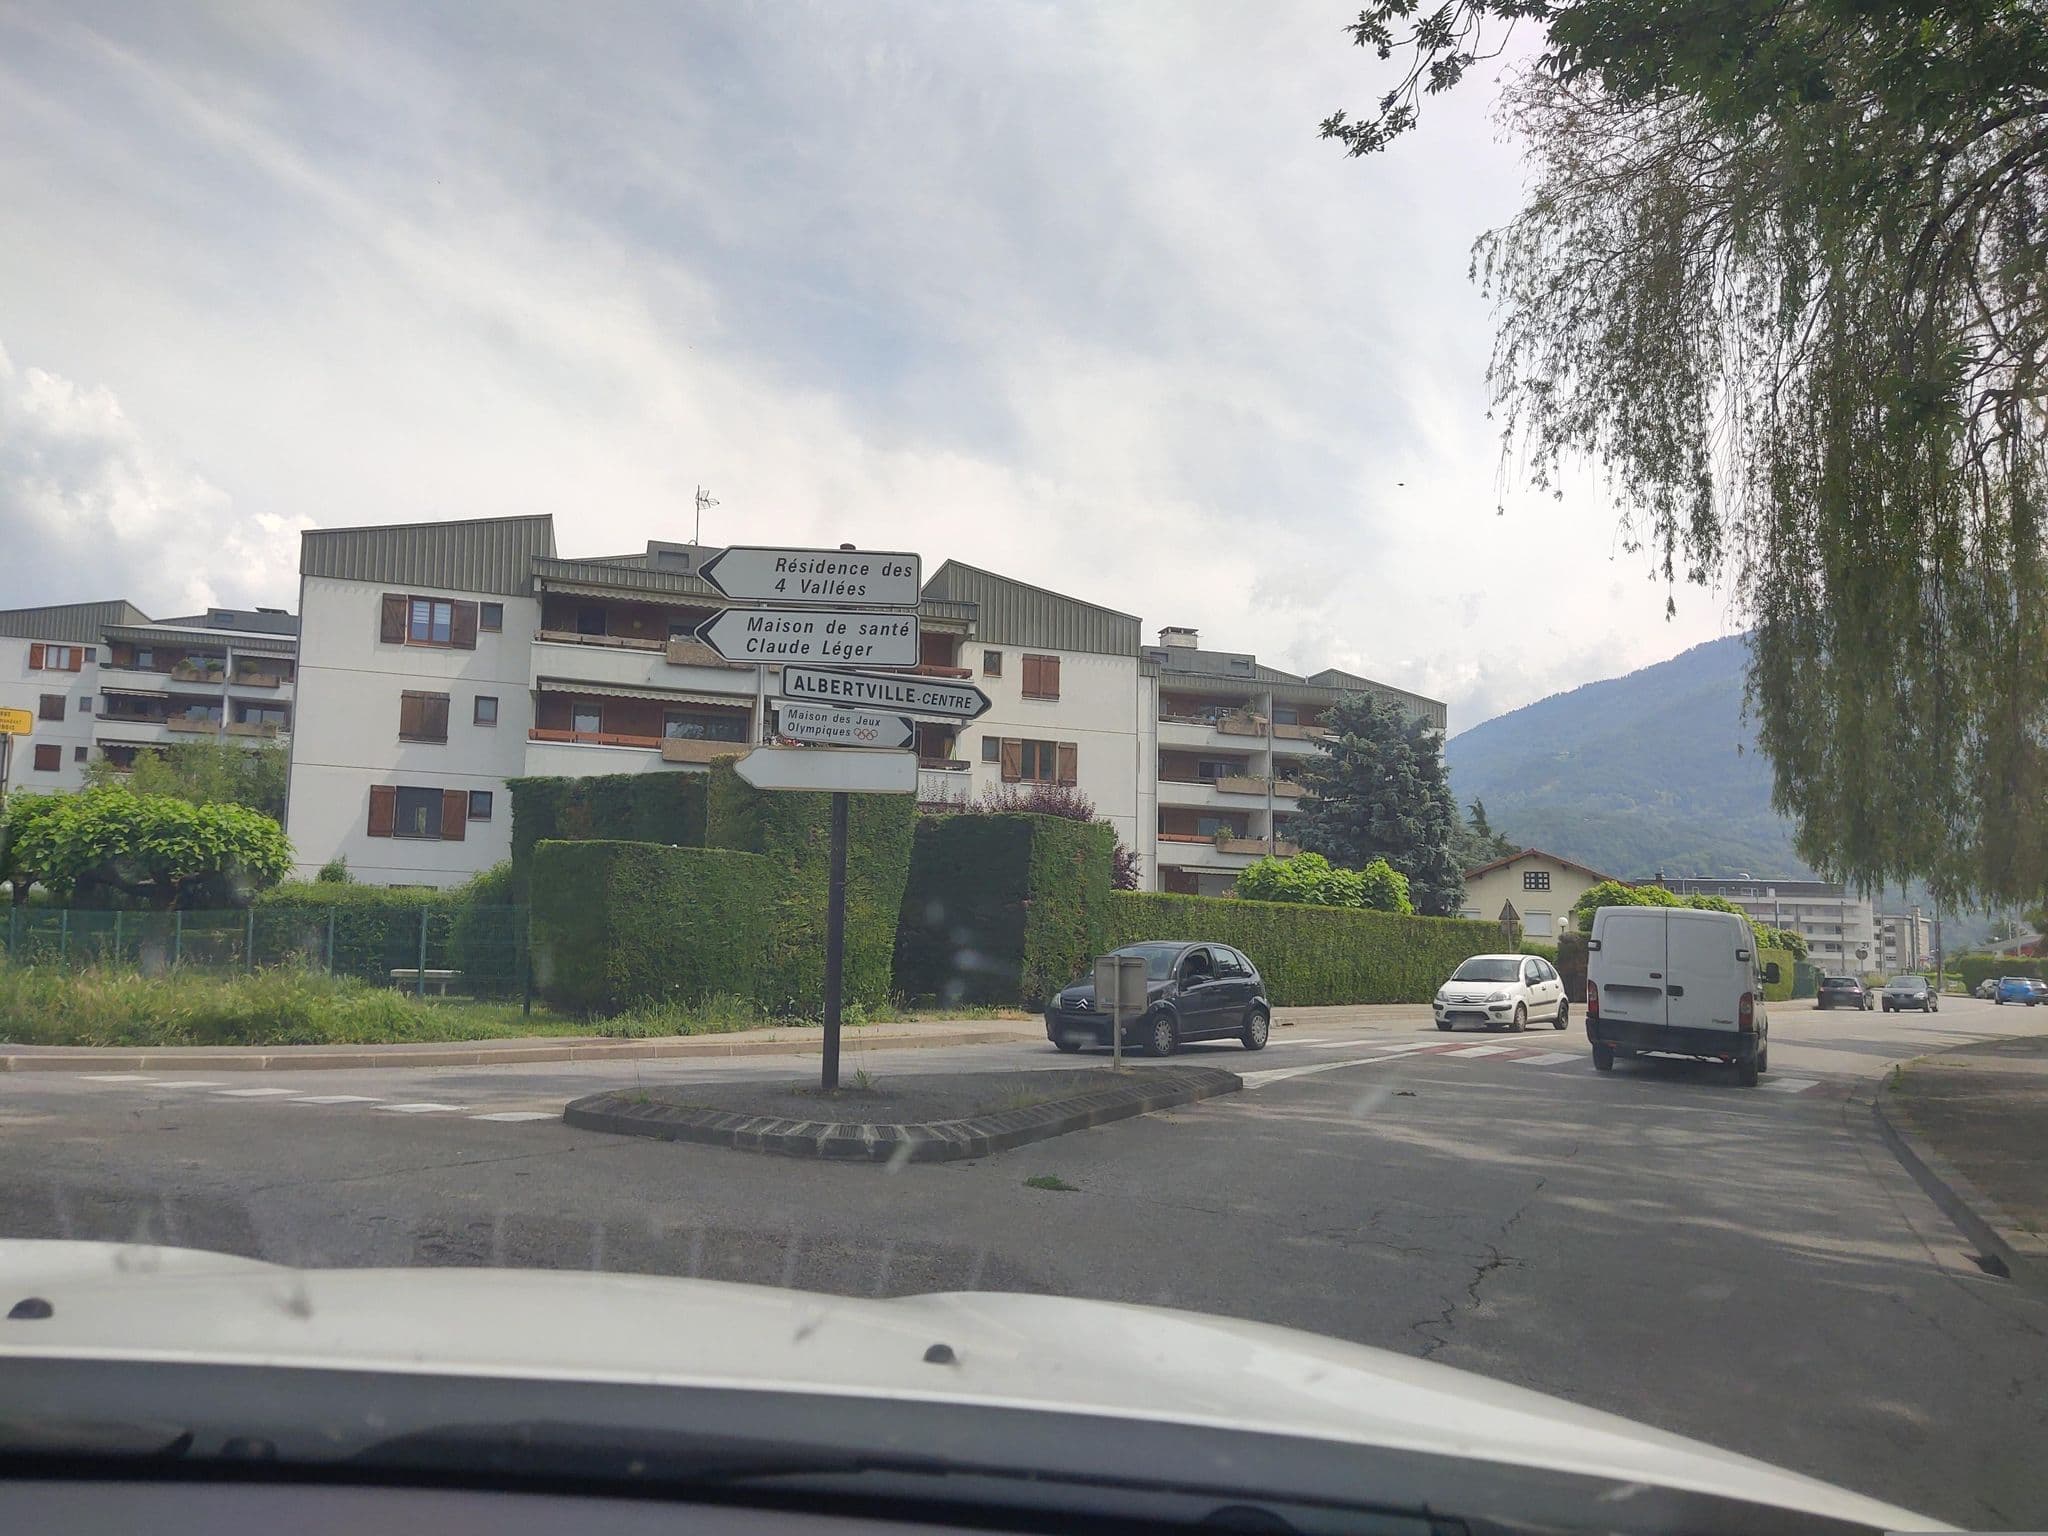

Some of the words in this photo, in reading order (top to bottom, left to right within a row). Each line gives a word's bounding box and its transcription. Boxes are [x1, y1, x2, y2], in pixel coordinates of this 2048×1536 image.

[775, 557, 870, 576] Résidence
[882, 562, 913, 578] des
[774, 578, 786, 593] 4
[800, 578, 867, 596] Vallées
[746, 617, 814, 634] Maison
[825, 620, 847, 635] de
[858, 622, 910, 637] santé
[746, 638, 811, 654] Claude
[821, 640, 874, 660] Léger
[787, 709, 829, 723] Maison
[832, 713, 851, 724] des
[855, 715, 881, 728] Jeux
[787, 722, 851, 738] Olympiques
